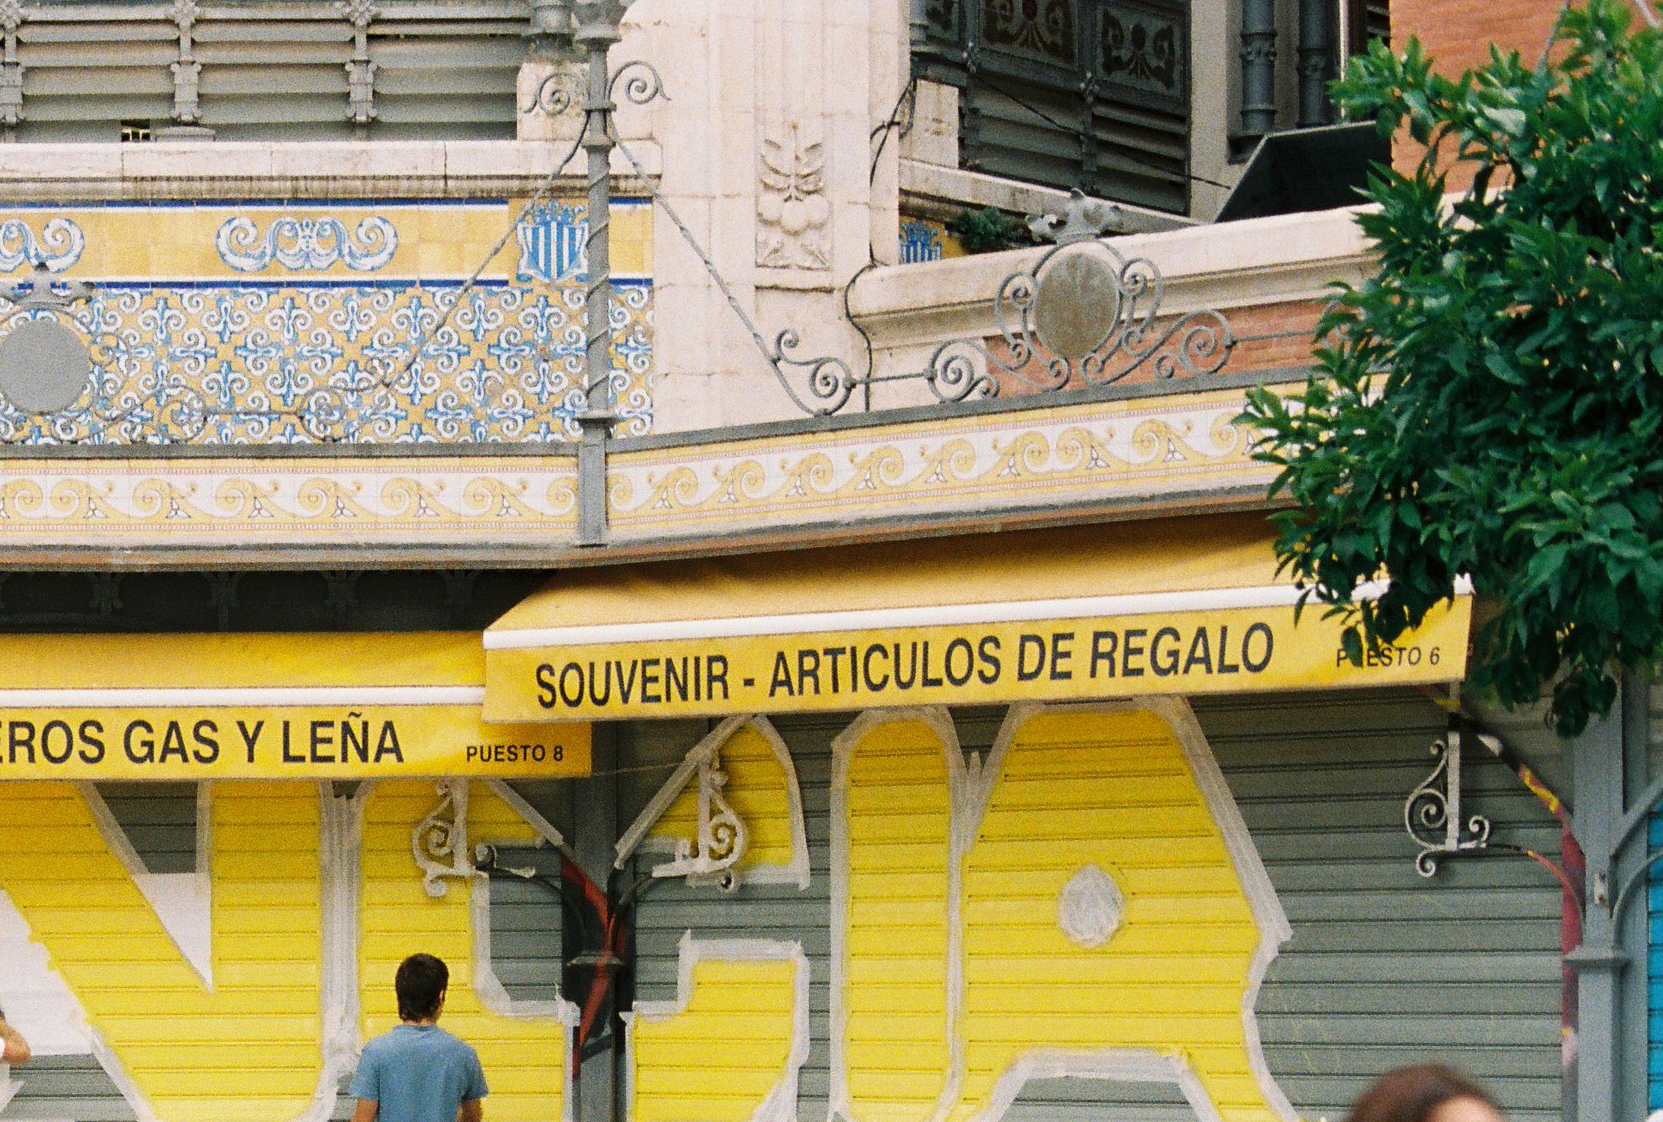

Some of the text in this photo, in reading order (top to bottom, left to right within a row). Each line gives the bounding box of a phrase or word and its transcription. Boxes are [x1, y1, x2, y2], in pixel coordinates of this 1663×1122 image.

[535, 654, 729, 709] SOUVENIR
[768, 635, 1002, 698] ARTICULOS
[1017, 632, 1075, 681] DE
[1090, 622, 1274, 679] REGALO
[1336, 646, 1441, 668] PESTO 6
[123, 719, 220, 764] GAS
[236, 720, 264, 763] Y
[282, 711, 404, 763] LEÑA
[466, 743, 565, 763] PUESTO 8
